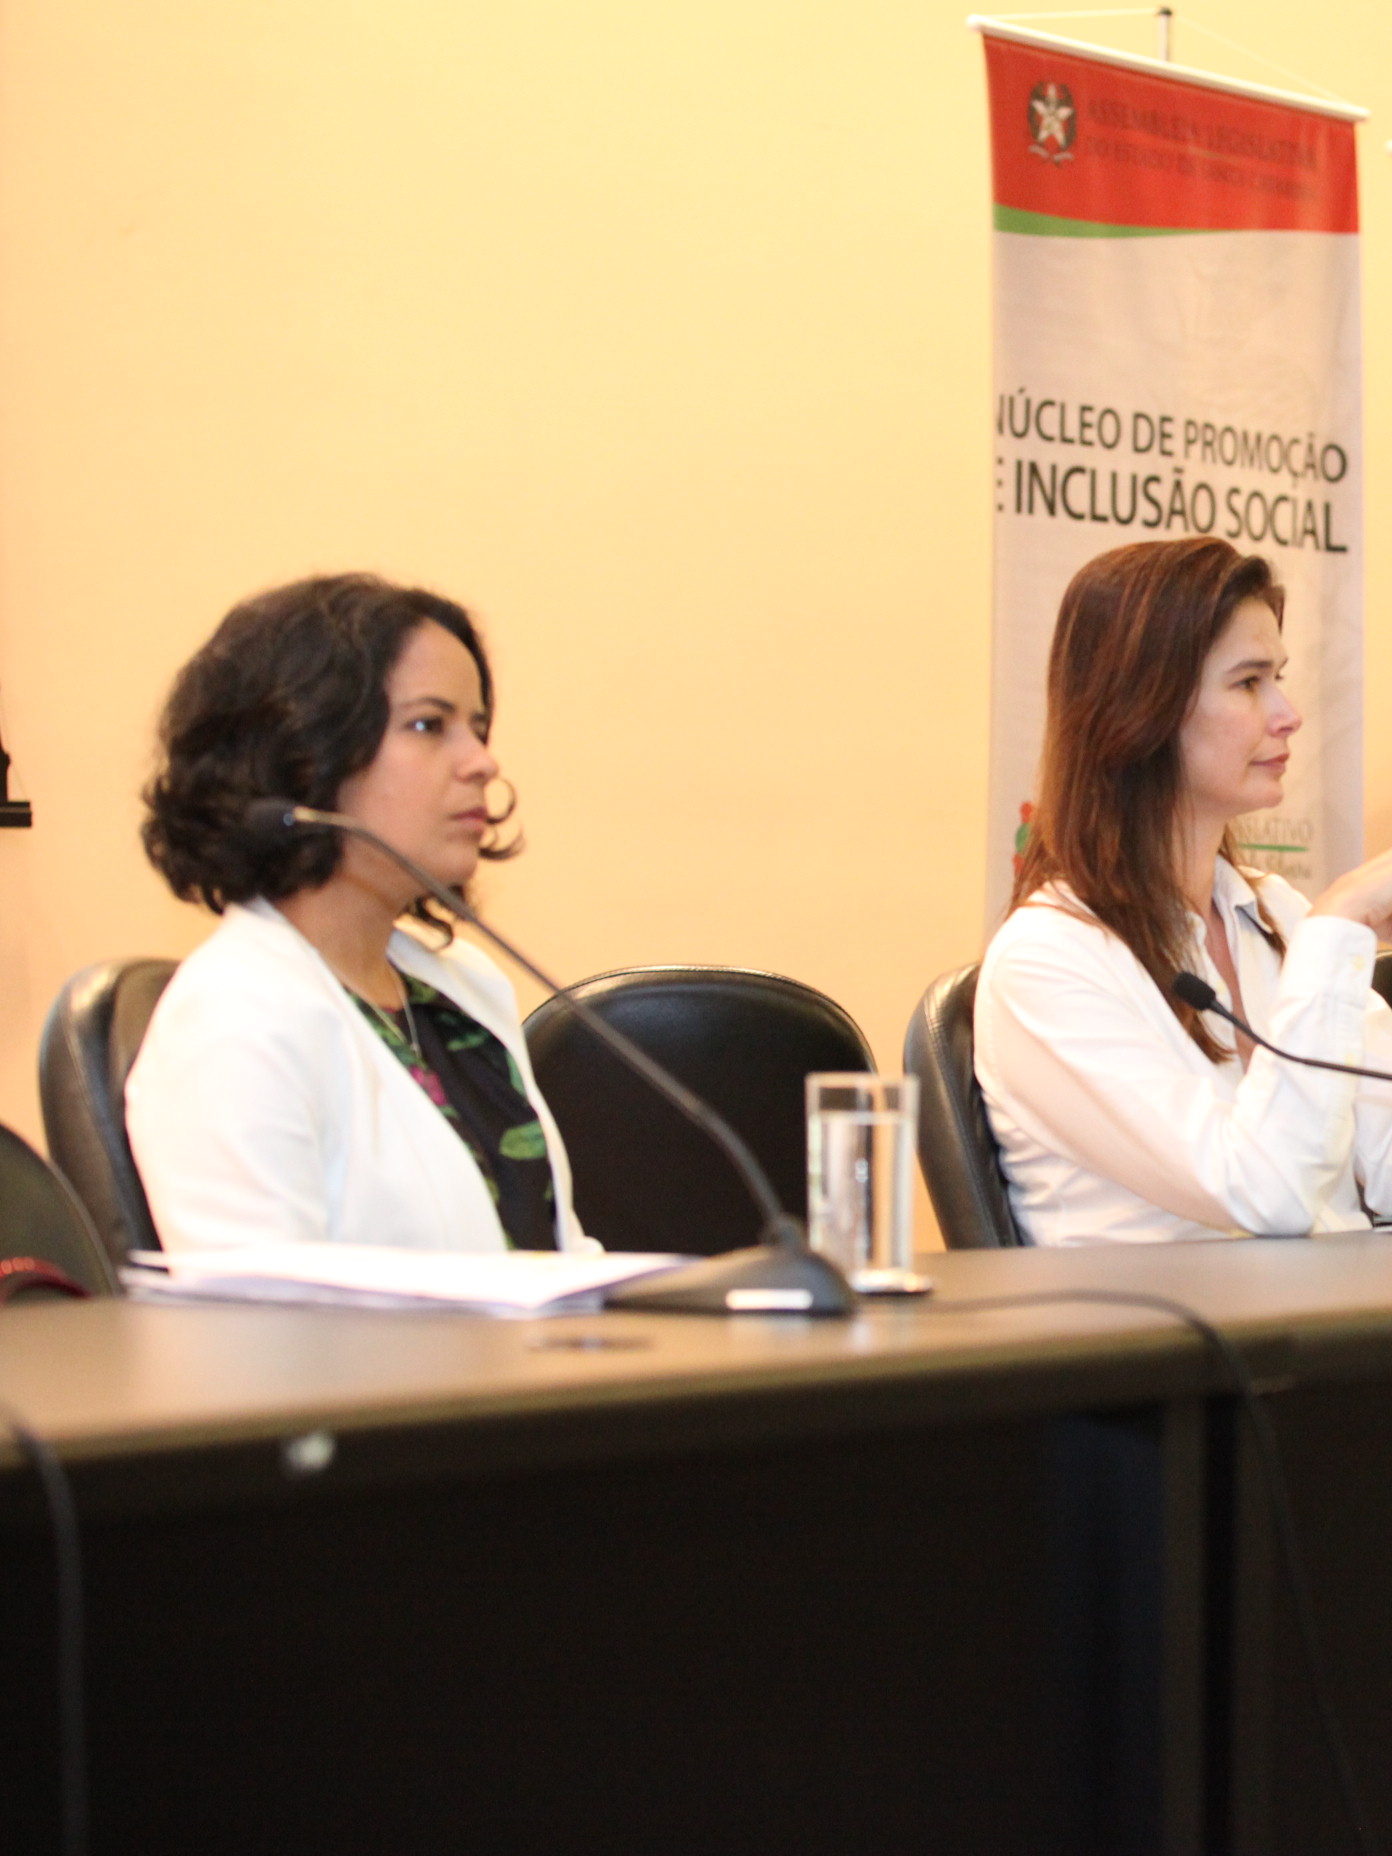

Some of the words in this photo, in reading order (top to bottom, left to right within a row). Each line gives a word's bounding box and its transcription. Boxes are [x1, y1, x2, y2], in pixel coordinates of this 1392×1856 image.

[1132, 411, 1175, 457] DE
[1184, 418, 1348, 488] PROMOÇÃO
[1015, 458, 1217, 535] INCLUSÃO
[1225, 486, 1348, 554] SOCIAL
